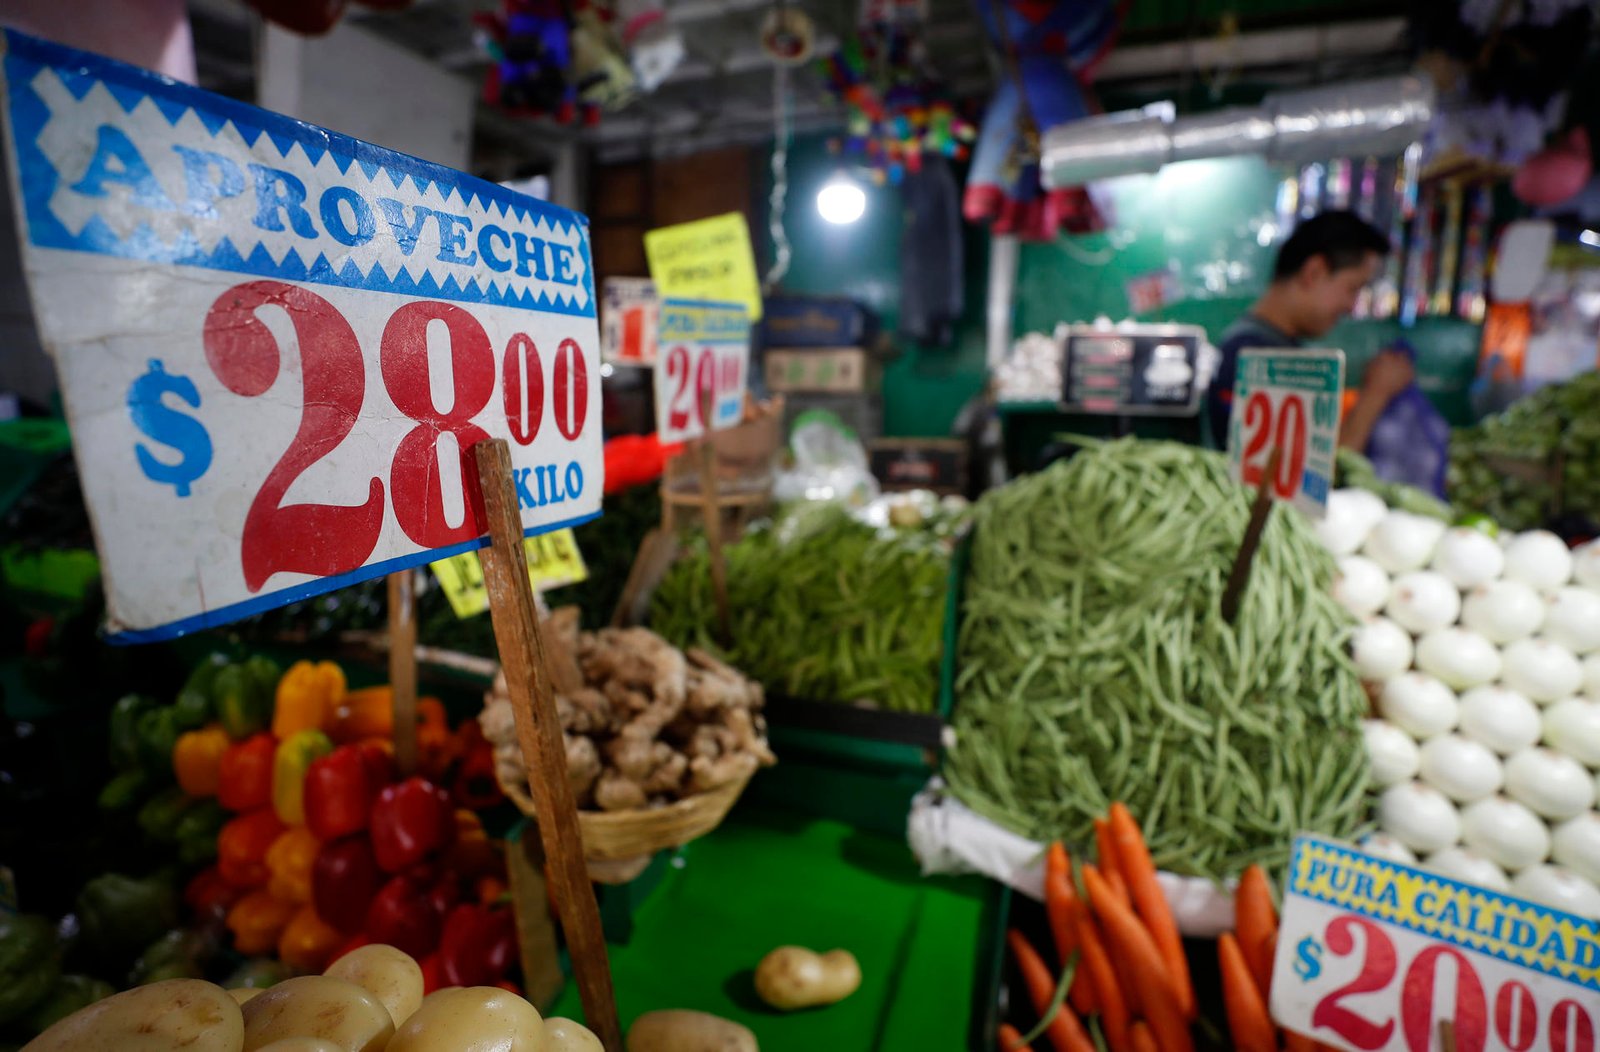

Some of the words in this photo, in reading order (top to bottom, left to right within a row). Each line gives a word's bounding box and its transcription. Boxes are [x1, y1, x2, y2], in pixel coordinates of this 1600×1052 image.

[70, 124, 579, 288] APROVECHE
[513, 461, 583, 510] KILO
[1307, 856, 1399, 908] PURA
[1414, 891, 1600, 970] CALIDAD
